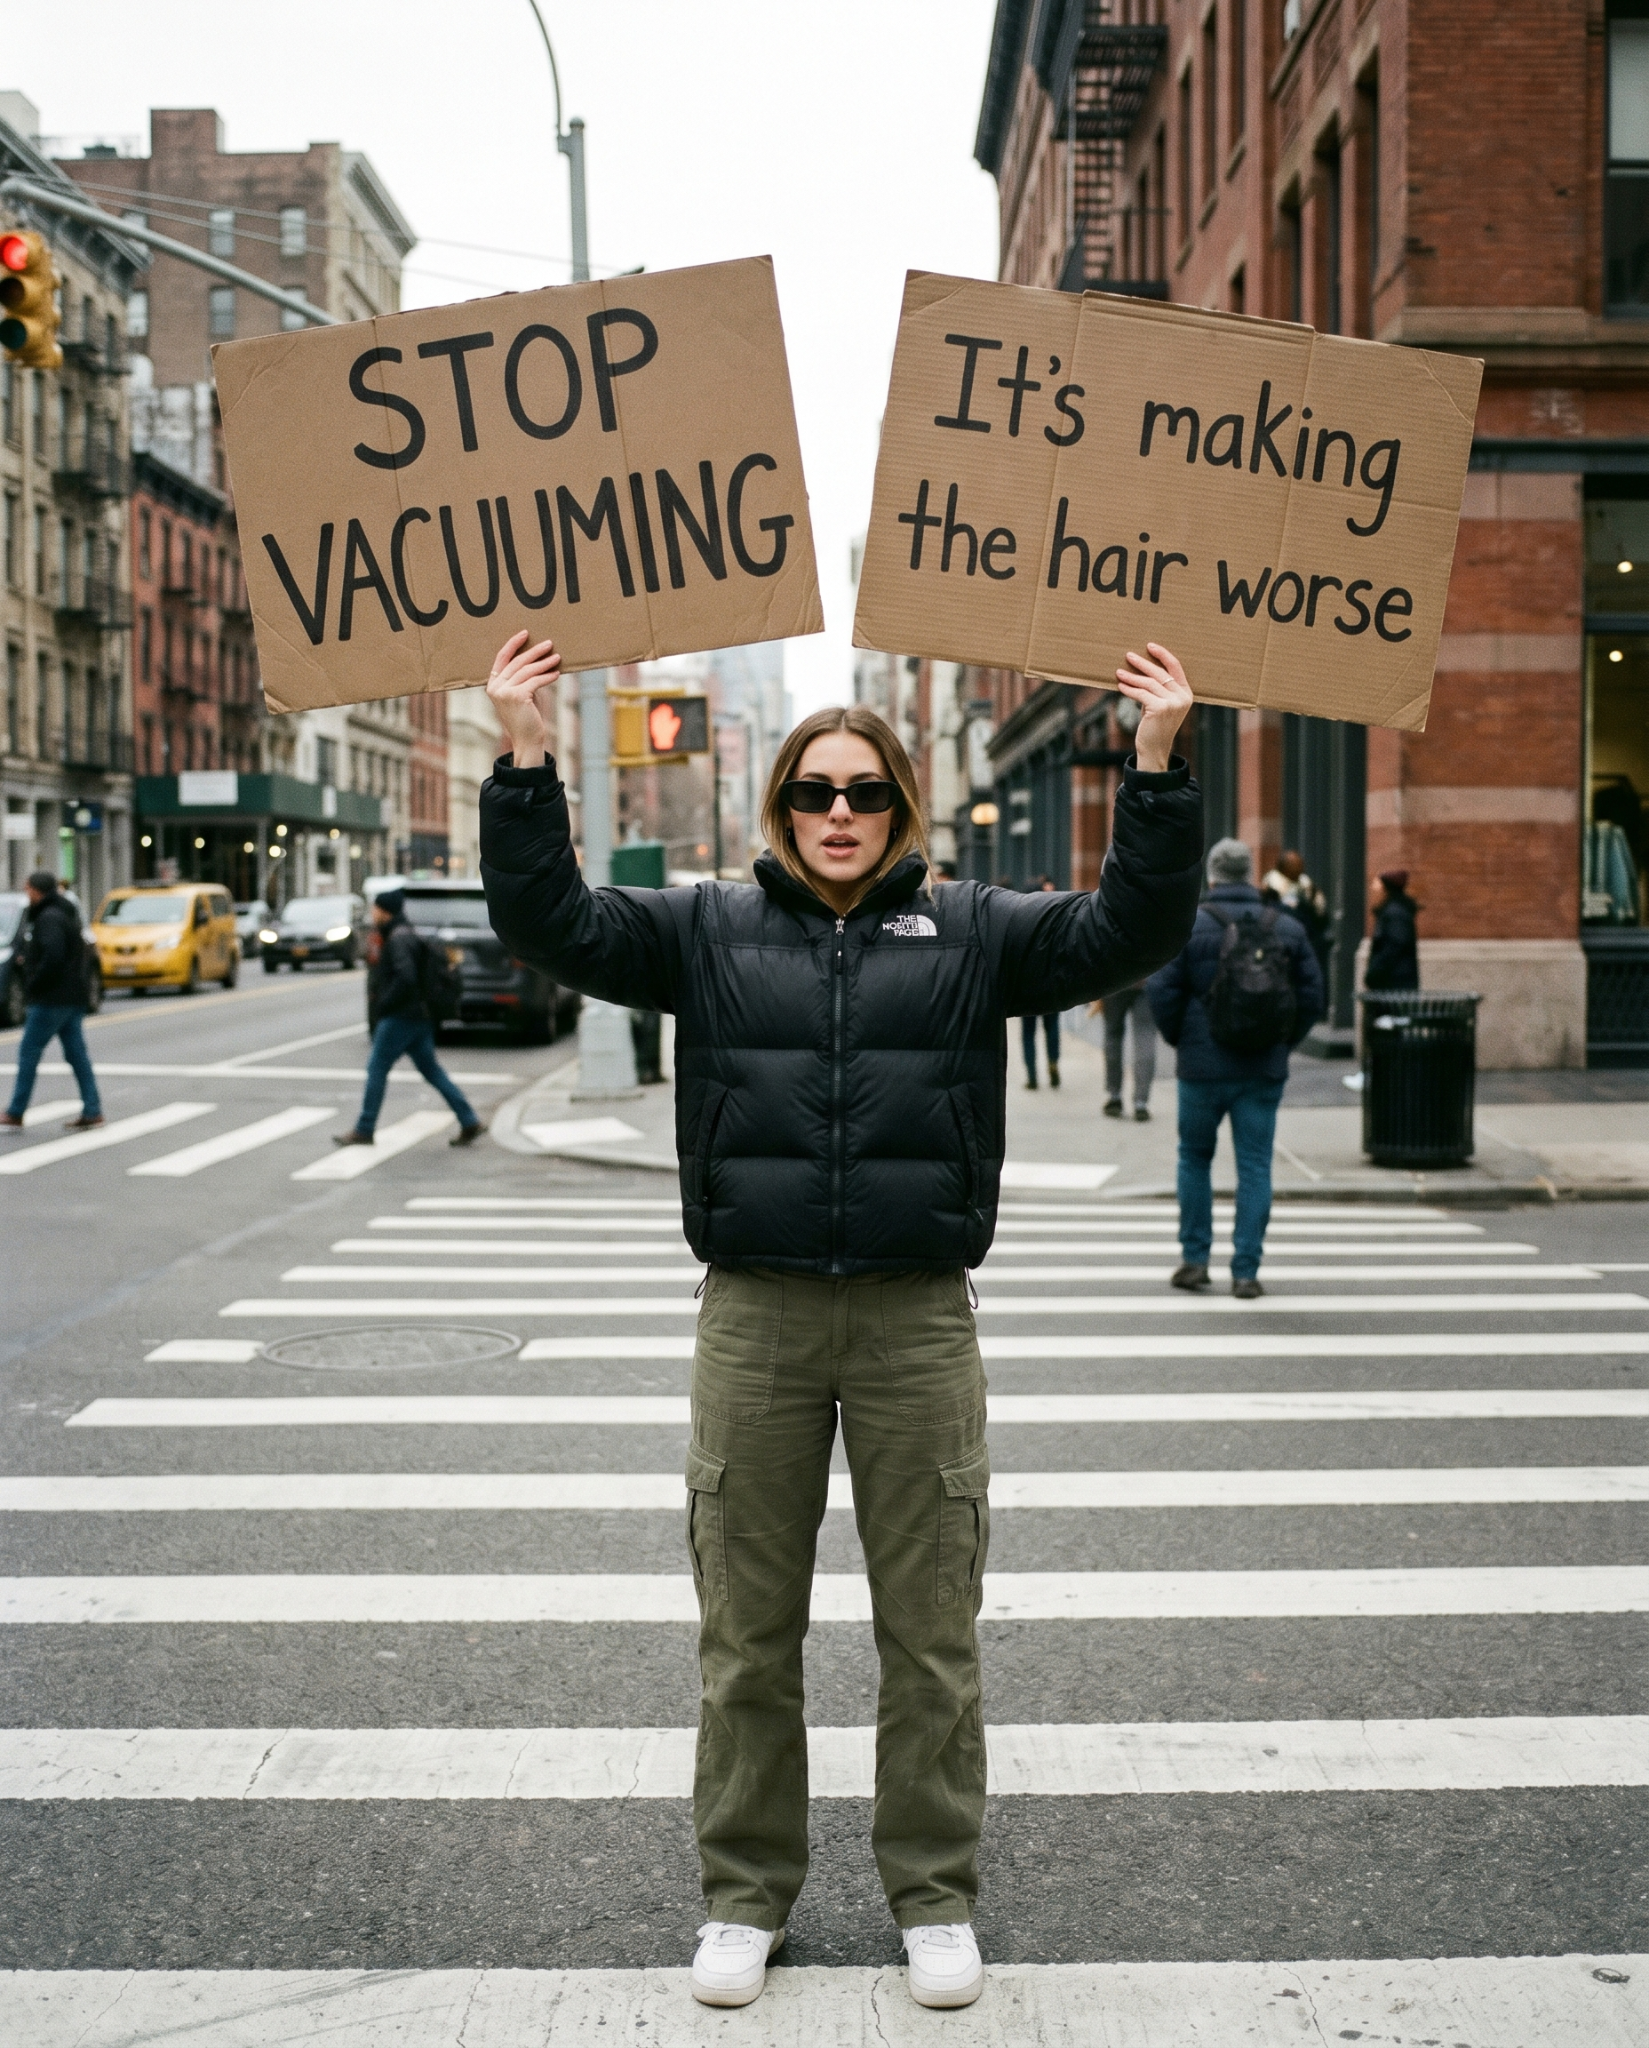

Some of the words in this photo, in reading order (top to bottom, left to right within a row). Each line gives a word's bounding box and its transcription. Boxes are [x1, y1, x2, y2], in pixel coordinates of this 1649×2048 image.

[349, 308, 658, 471] STOP
[934, 333, 1086, 447] It's
[1140, 380, 1402, 538] making
[262, 453, 795, 646] VACUUMING
[898, 479, 1017, 581] the
[1048, 497, 1189, 604] hair
[1217, 560, 1413, 643] worse
[896, 915, 917, 923] THE
